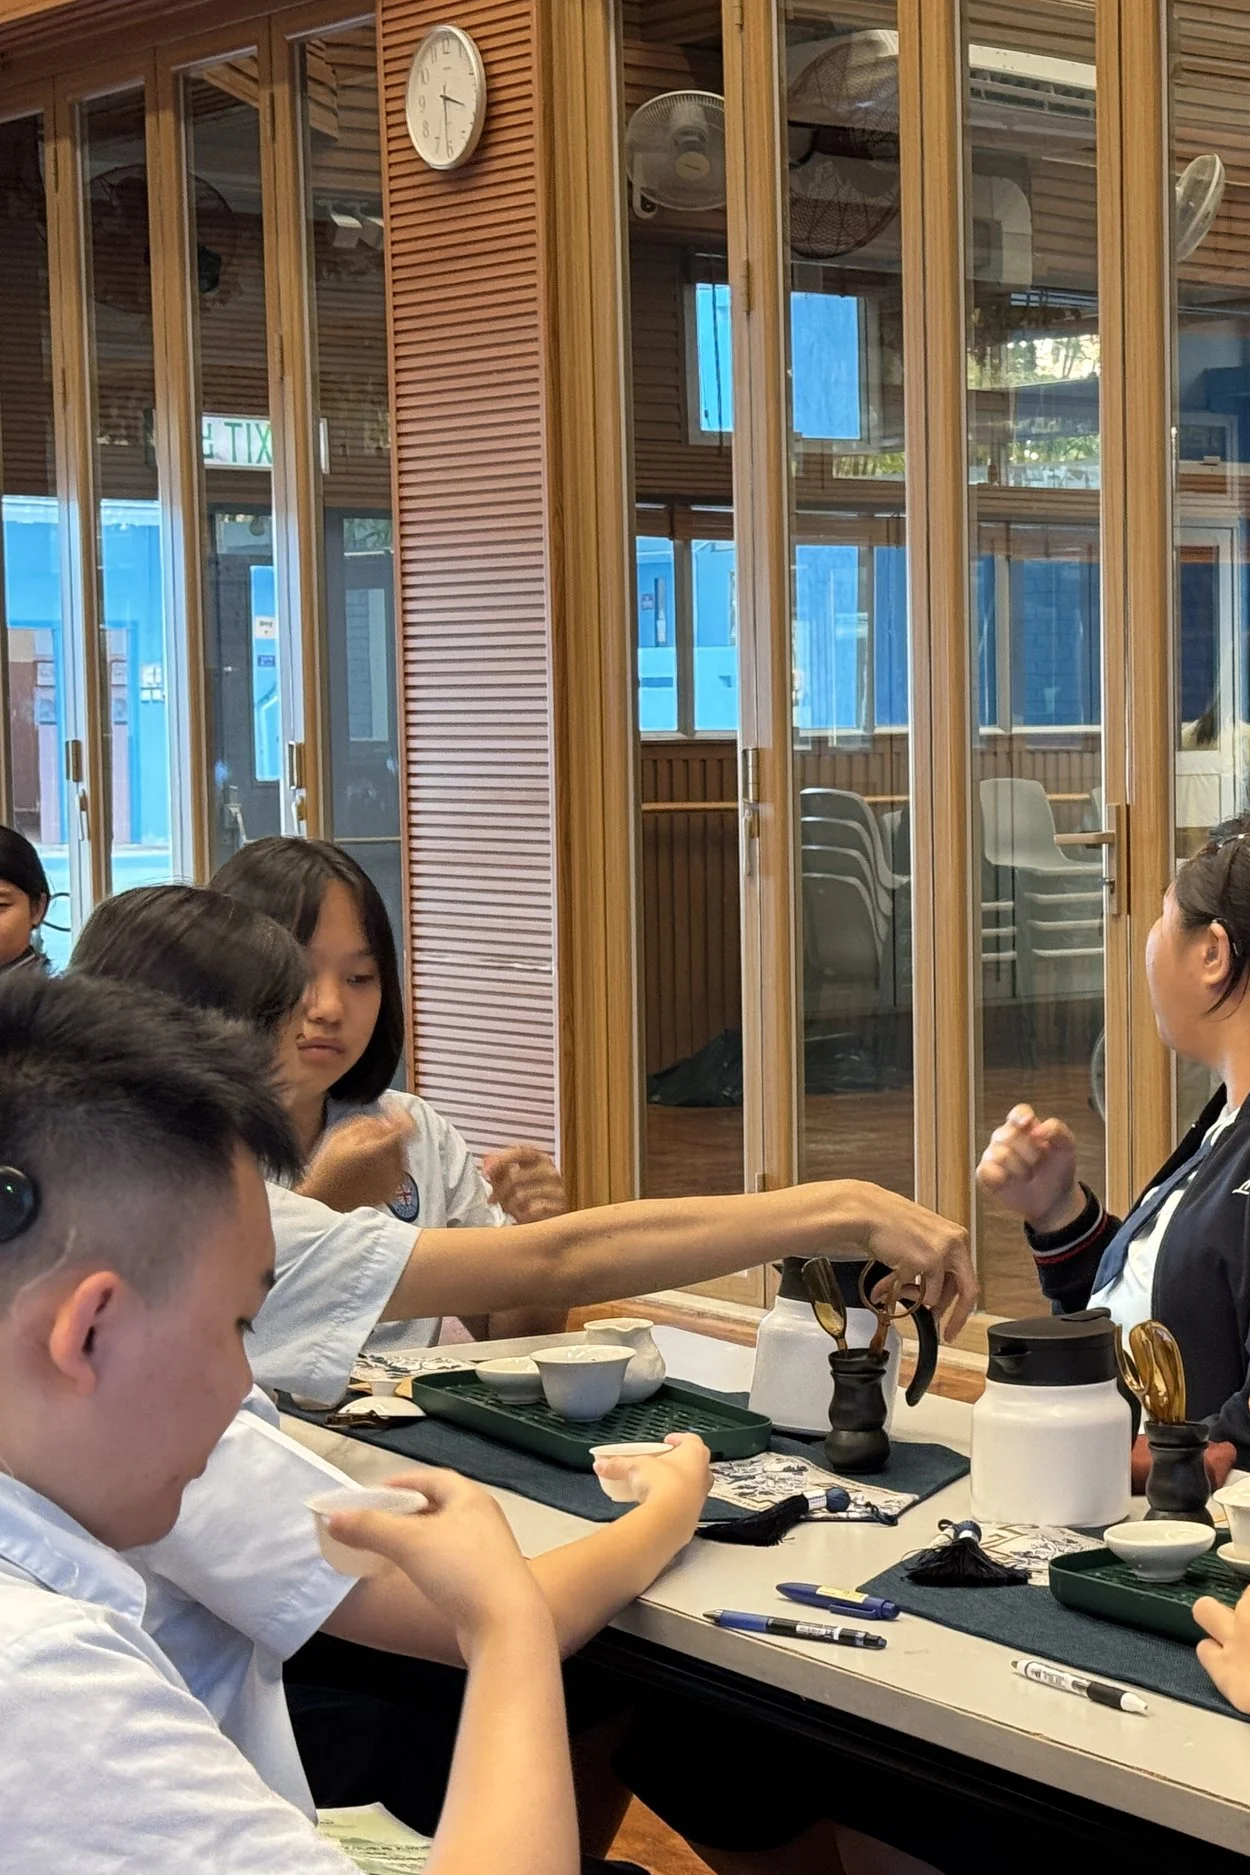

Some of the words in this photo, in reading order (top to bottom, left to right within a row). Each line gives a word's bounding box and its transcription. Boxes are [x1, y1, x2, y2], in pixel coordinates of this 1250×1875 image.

[421, 67, 430, 86] 10
[418, 95, 426, 114] 9
[422, 120, 430, 139] 8
